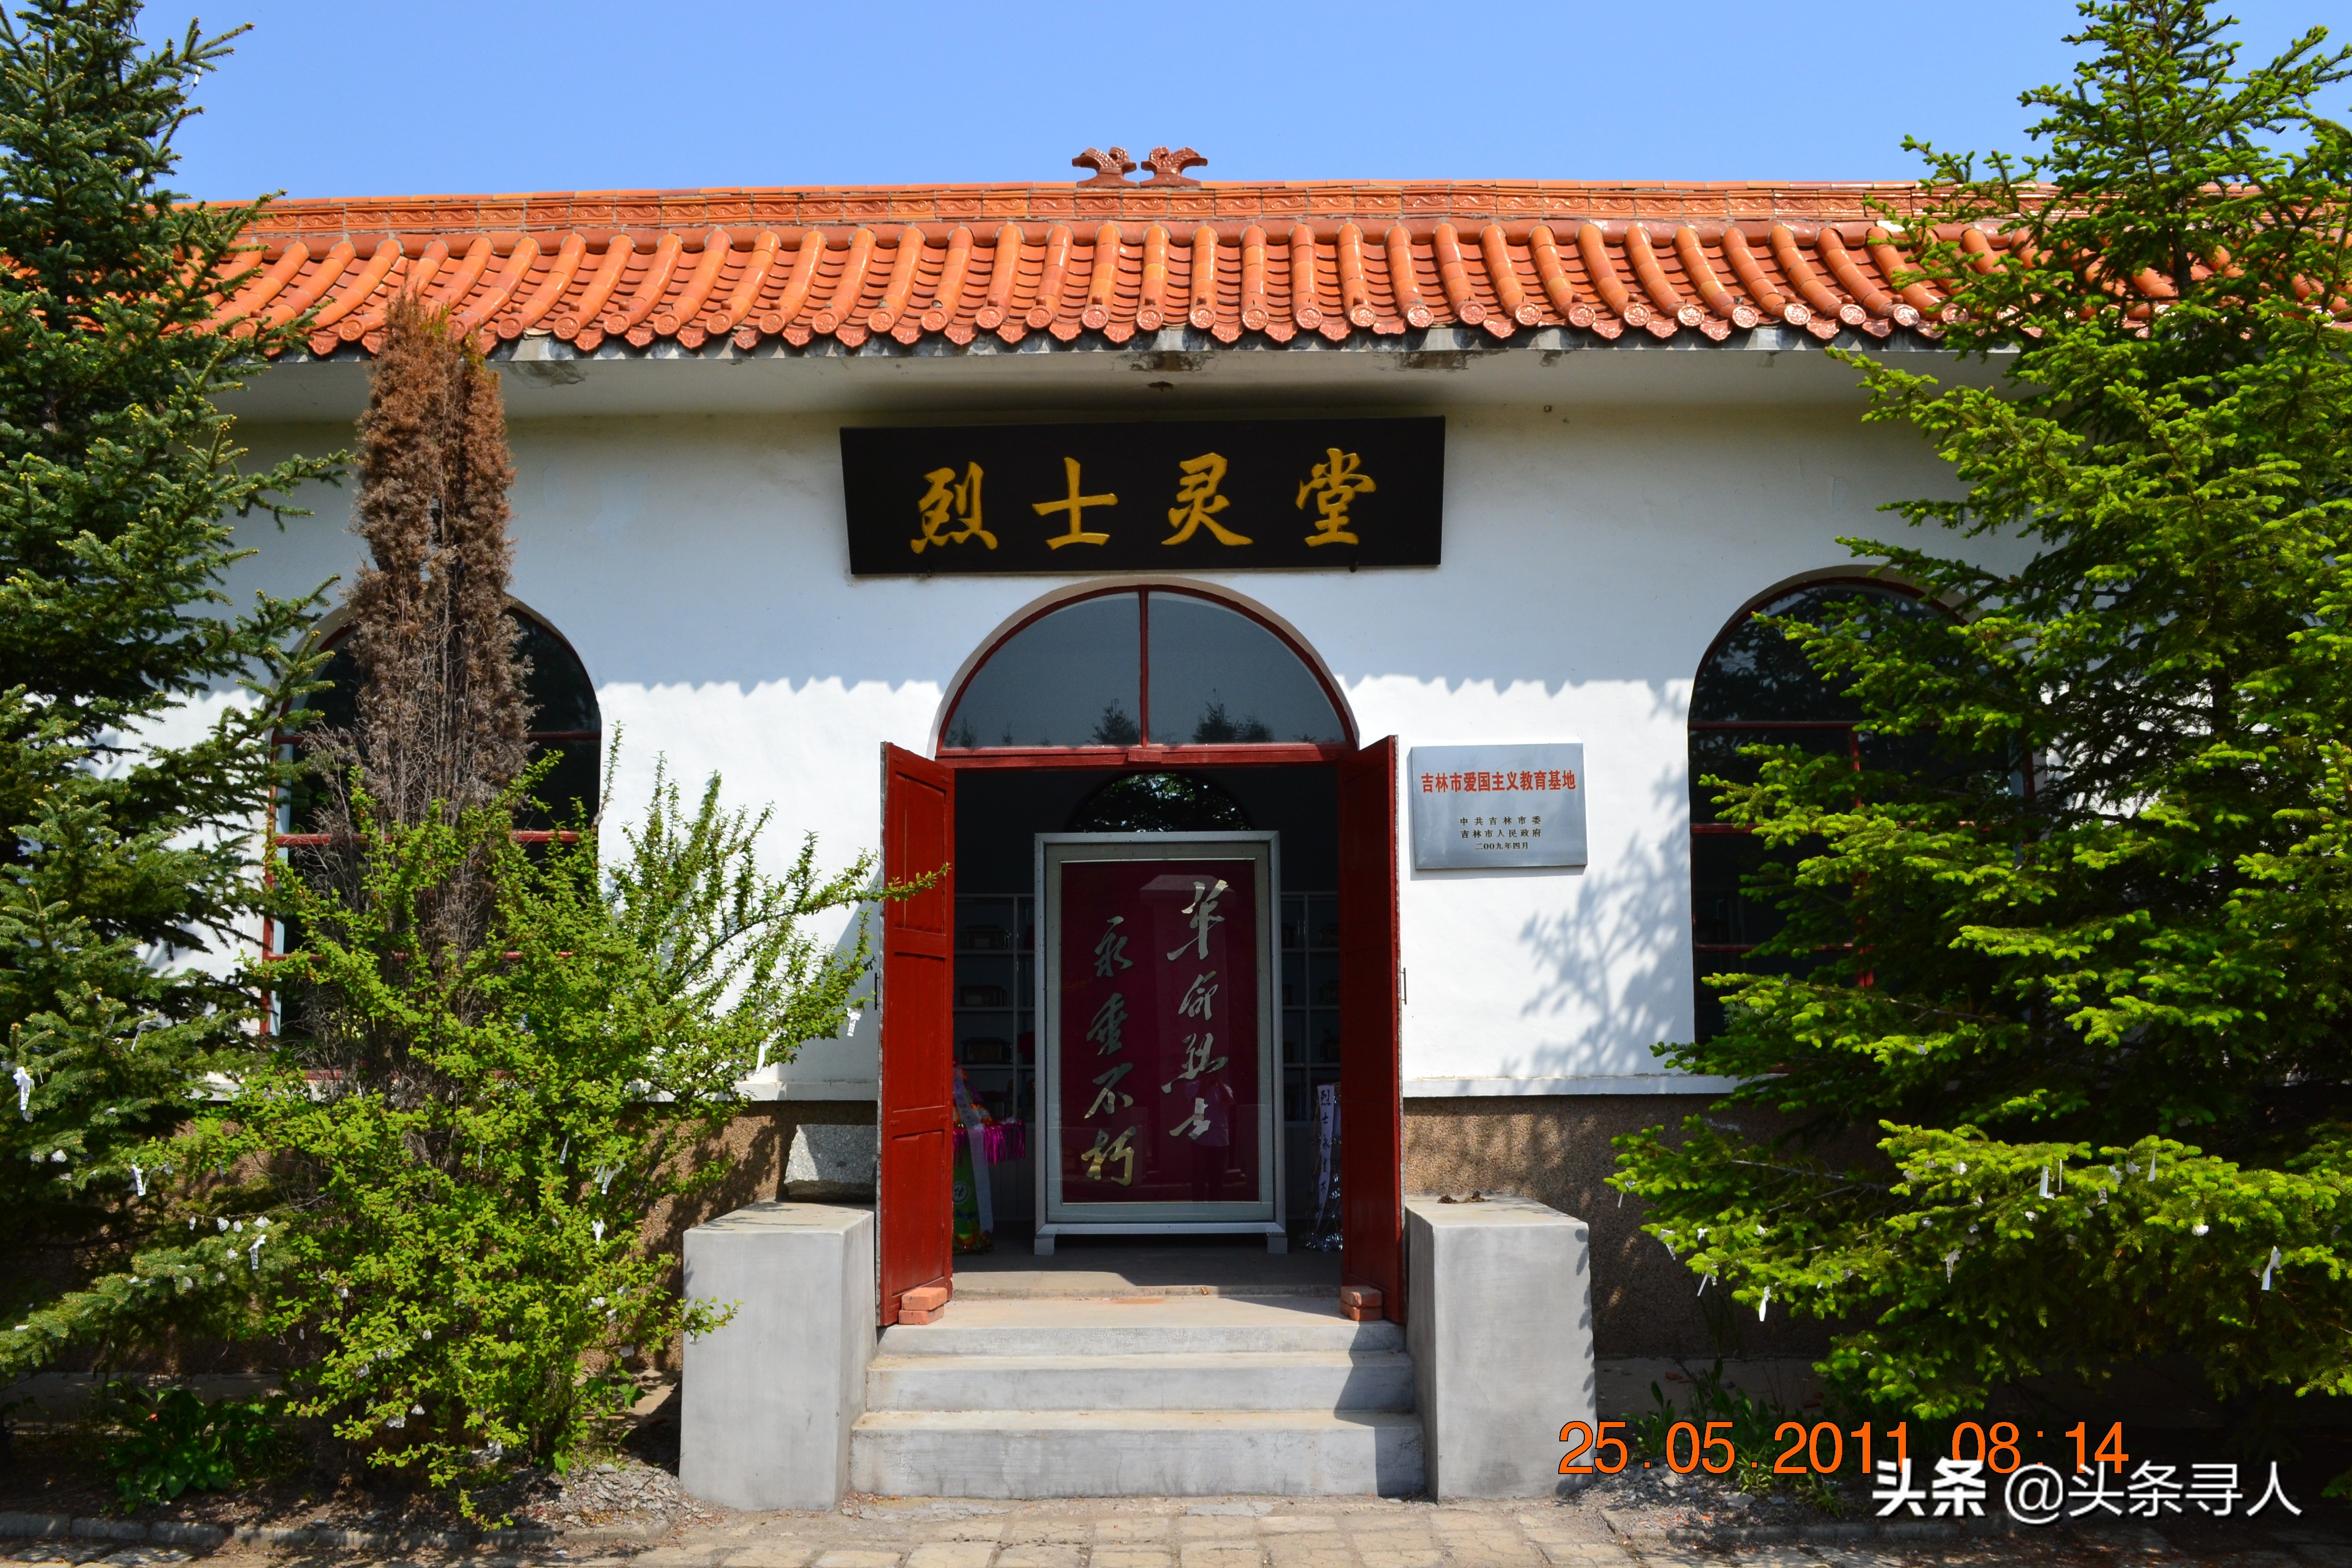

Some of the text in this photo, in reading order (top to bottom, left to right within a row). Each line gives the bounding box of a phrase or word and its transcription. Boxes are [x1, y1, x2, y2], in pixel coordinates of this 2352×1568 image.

[911, 447, 1376, 554] 烈士灵堂
[1421, 770, 1577, 793] 吉林市爱国主义教育基地
[1460, 816, 1541, 826] 中共吉林市委
[1460, 828, 1541, 839] 吉林市人民政府
[1162, 879, 1229, 1138] 革命烈士
[1081, 916, 1136, 1186] 永垂不朽
